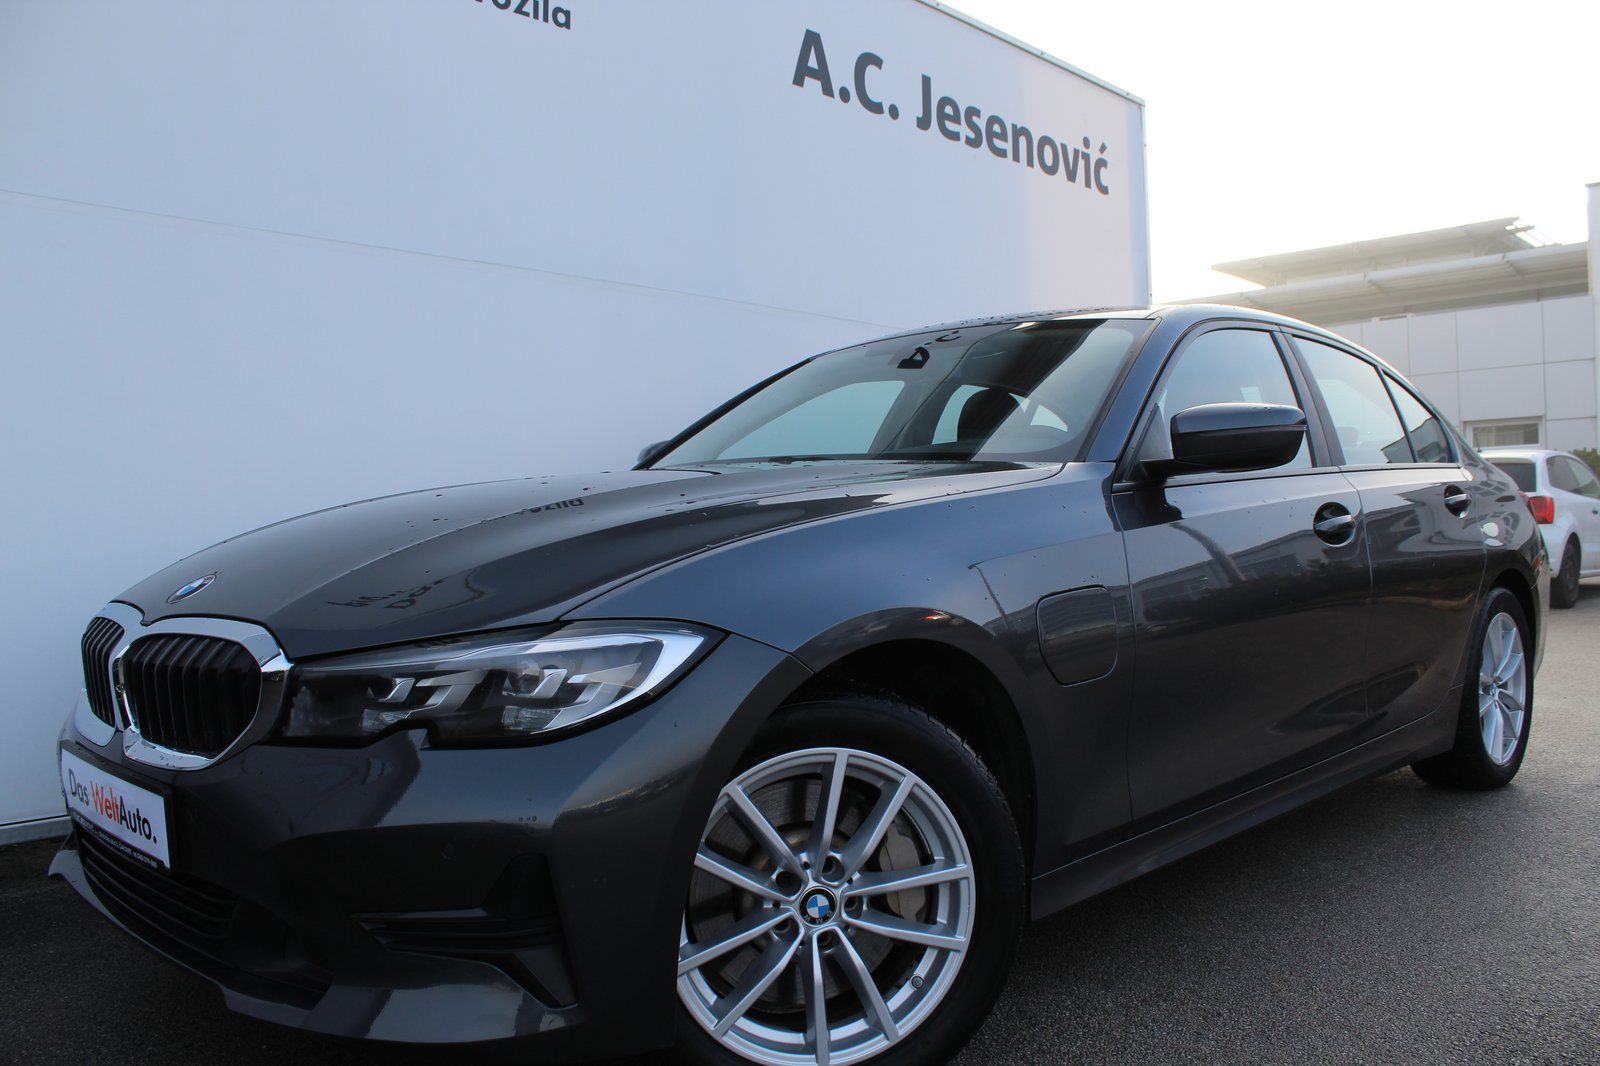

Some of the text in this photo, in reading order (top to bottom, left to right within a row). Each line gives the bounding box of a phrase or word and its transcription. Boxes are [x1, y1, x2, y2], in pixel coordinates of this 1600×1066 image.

[475, 0, 571, 30] zila
[792, 28, 1109, 195] A.C. Jesenović
[68, 768, 89, 806] Das
[90, 781, 158, 844] WeltAuto.
